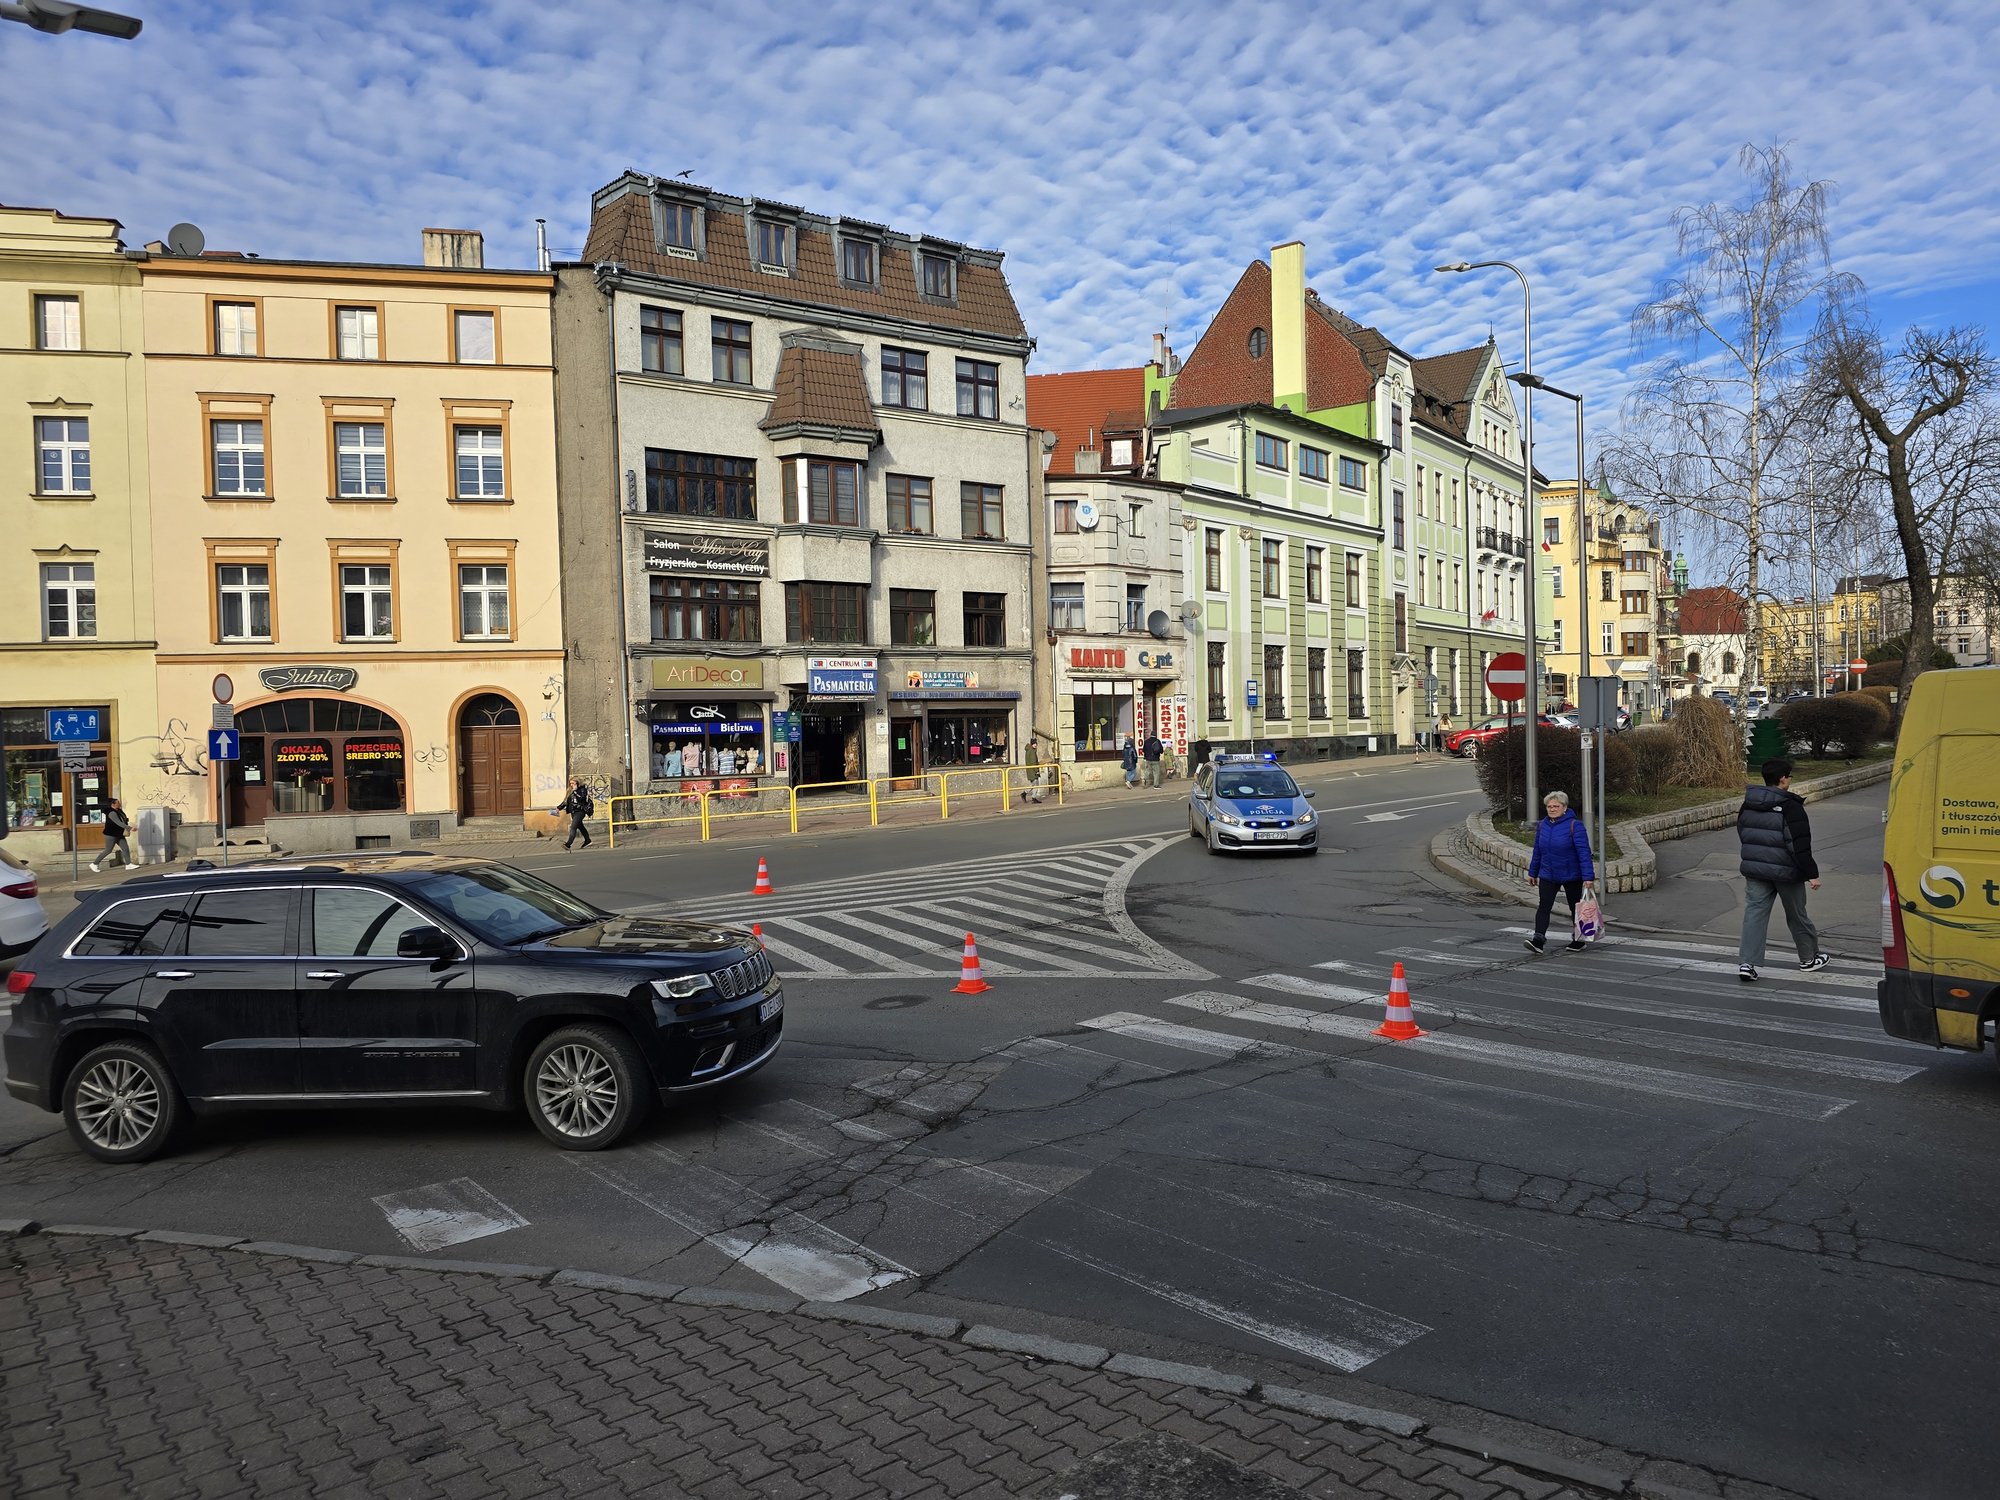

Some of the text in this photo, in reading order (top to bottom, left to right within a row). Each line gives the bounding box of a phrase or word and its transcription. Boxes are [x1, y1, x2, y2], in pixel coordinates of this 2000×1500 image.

[653, 538, 680, 550] Salon
[690, 536, 726, 555] Miss
[649, 556, 698, 569] Fryzjersko
[706, 559, 765, 575] Kosmetyczny
[1138, 651, 1173, 670] Cent
[265, 668, 348, 687] Jubiler
[667, 666, 749, 682] ArtDecor
[1161, 704, 1172, 739] KANTOR
[1177, 705, 1187, 754] KANTOR
[281, 745, 324, 754] OKAZJA
[345, 743, 401, 752] PRZECENA
[277, 754, 307, 762] ZŁOTO
[346, 752, 381, 760] SREBRO
[1942, 798, 1999, 809] Dostawa,
[1942, 811, 1945, 820] i
[1941, 826, 1970, 835] gmin
[1974, 826, 1977, 834] i
